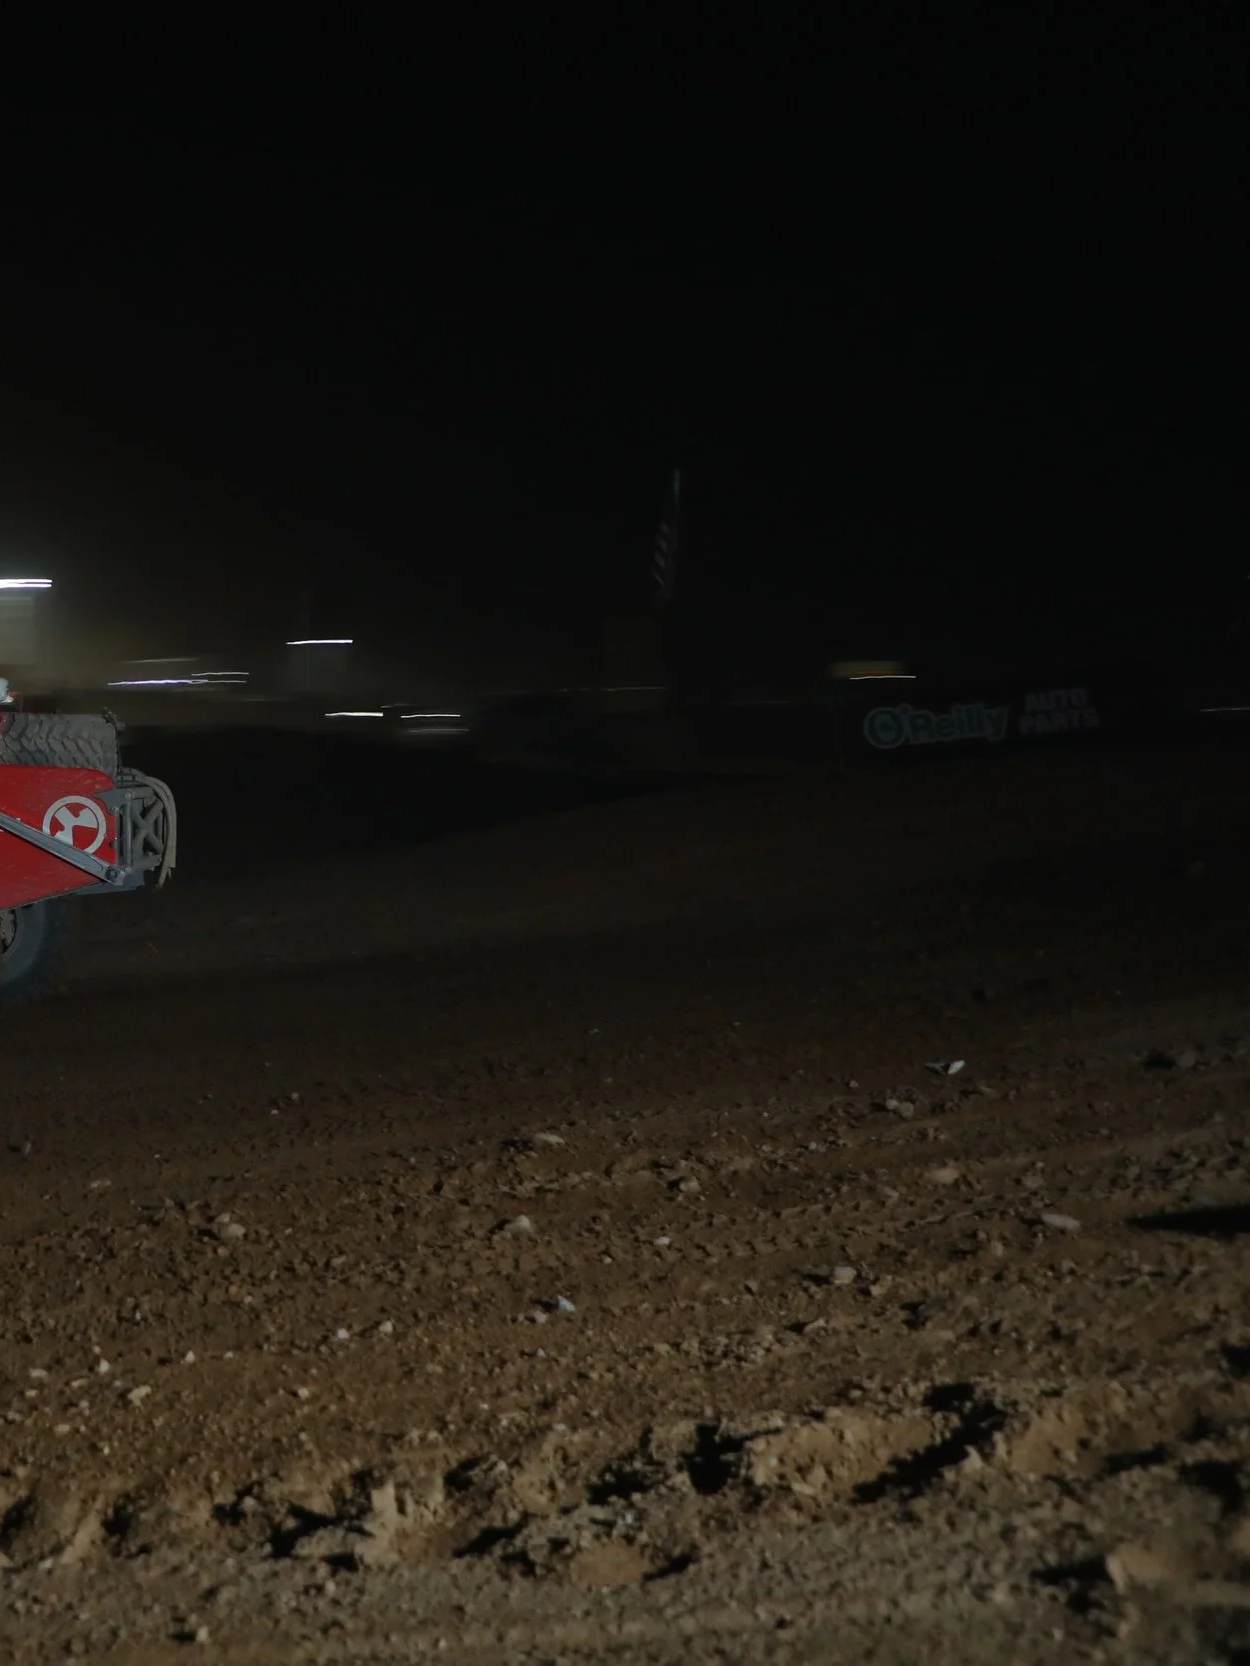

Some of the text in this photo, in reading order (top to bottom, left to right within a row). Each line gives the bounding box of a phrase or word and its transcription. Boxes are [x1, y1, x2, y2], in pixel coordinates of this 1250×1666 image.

[1024, 688, 1089, 713] AUTO
[863, 701, 1010, 749] O'Reilly
[1018, 706, 1100, 735] PARTS
